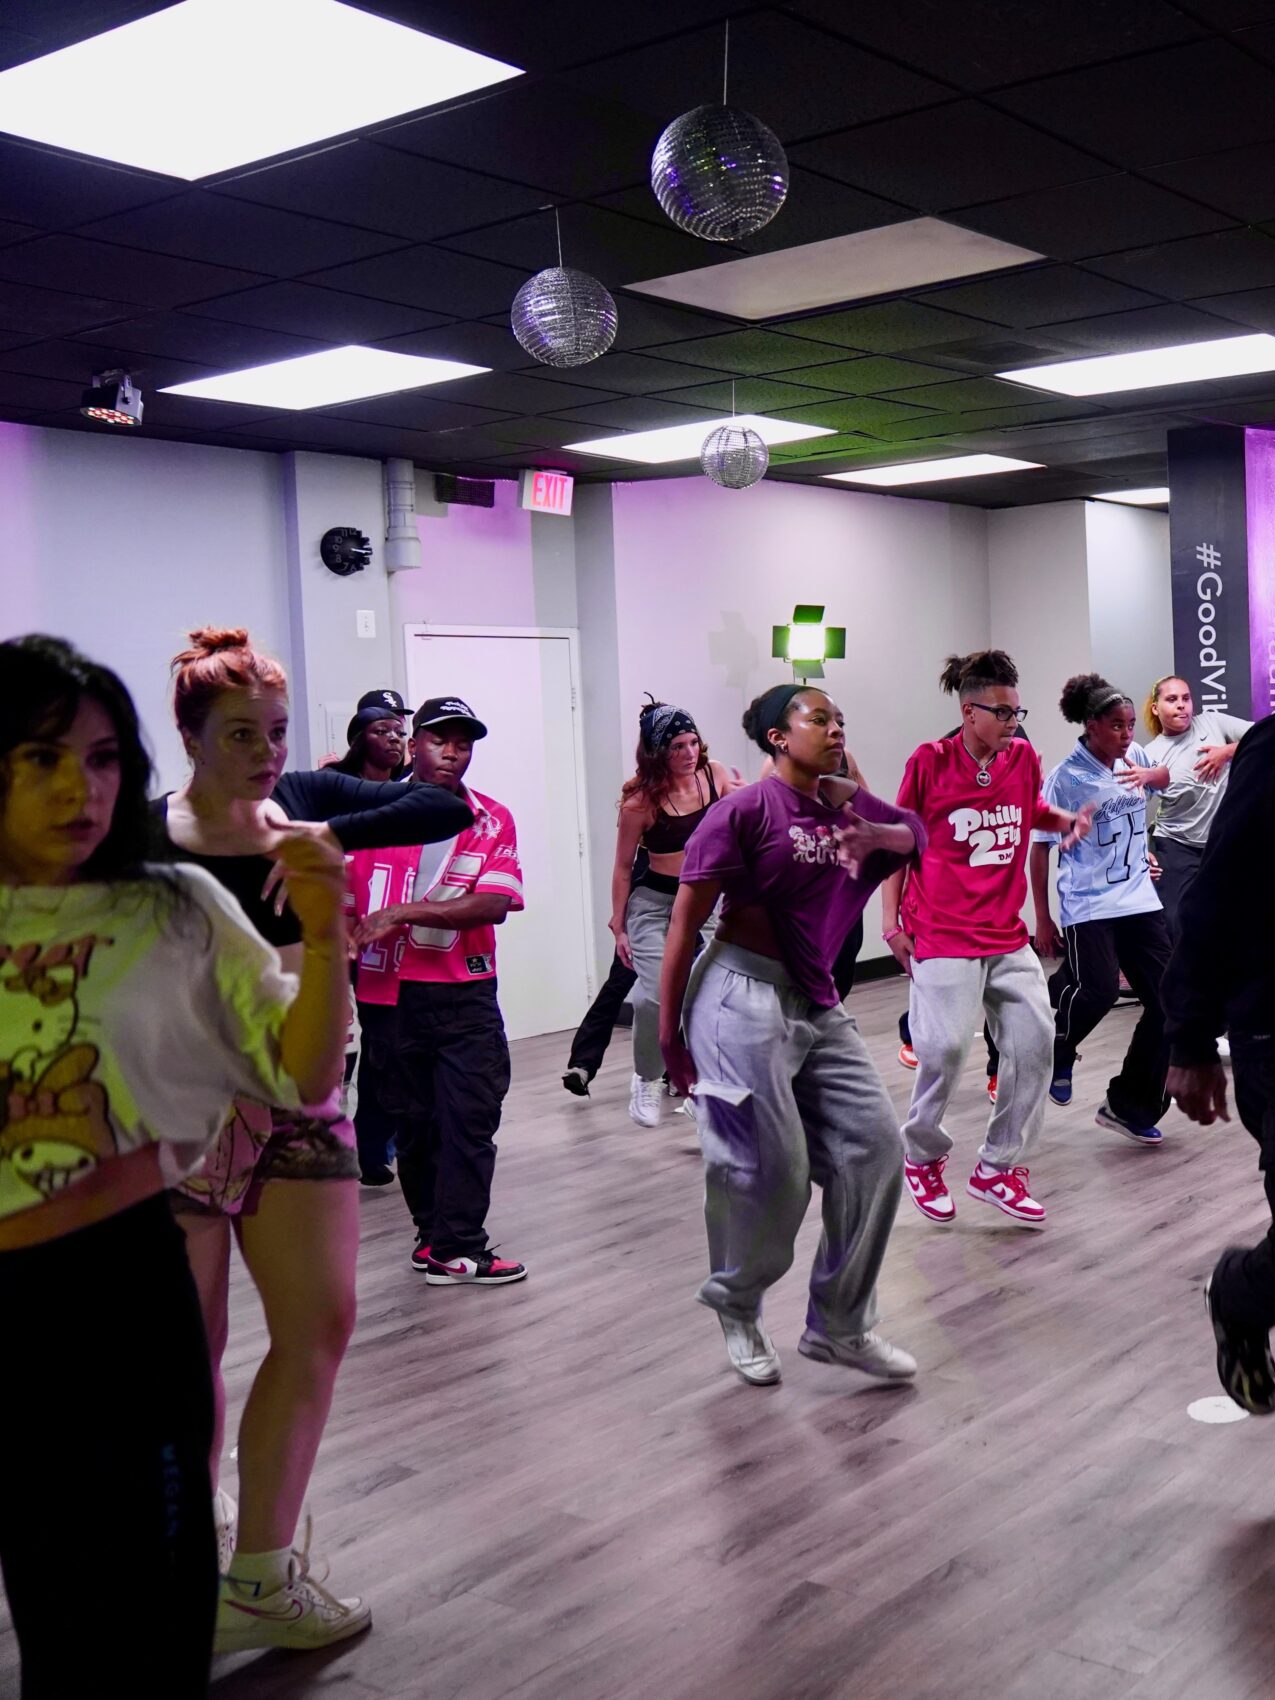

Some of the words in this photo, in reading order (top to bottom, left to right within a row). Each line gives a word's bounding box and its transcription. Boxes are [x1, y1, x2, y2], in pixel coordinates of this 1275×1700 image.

[531, 472, 568, 510] EXIT
[332, 544, 340, 553] 9
[335, 554, 342, 563] 8
[948, 805, 1022, 842] Philly
[995, 825, 1021, 846] Fly
